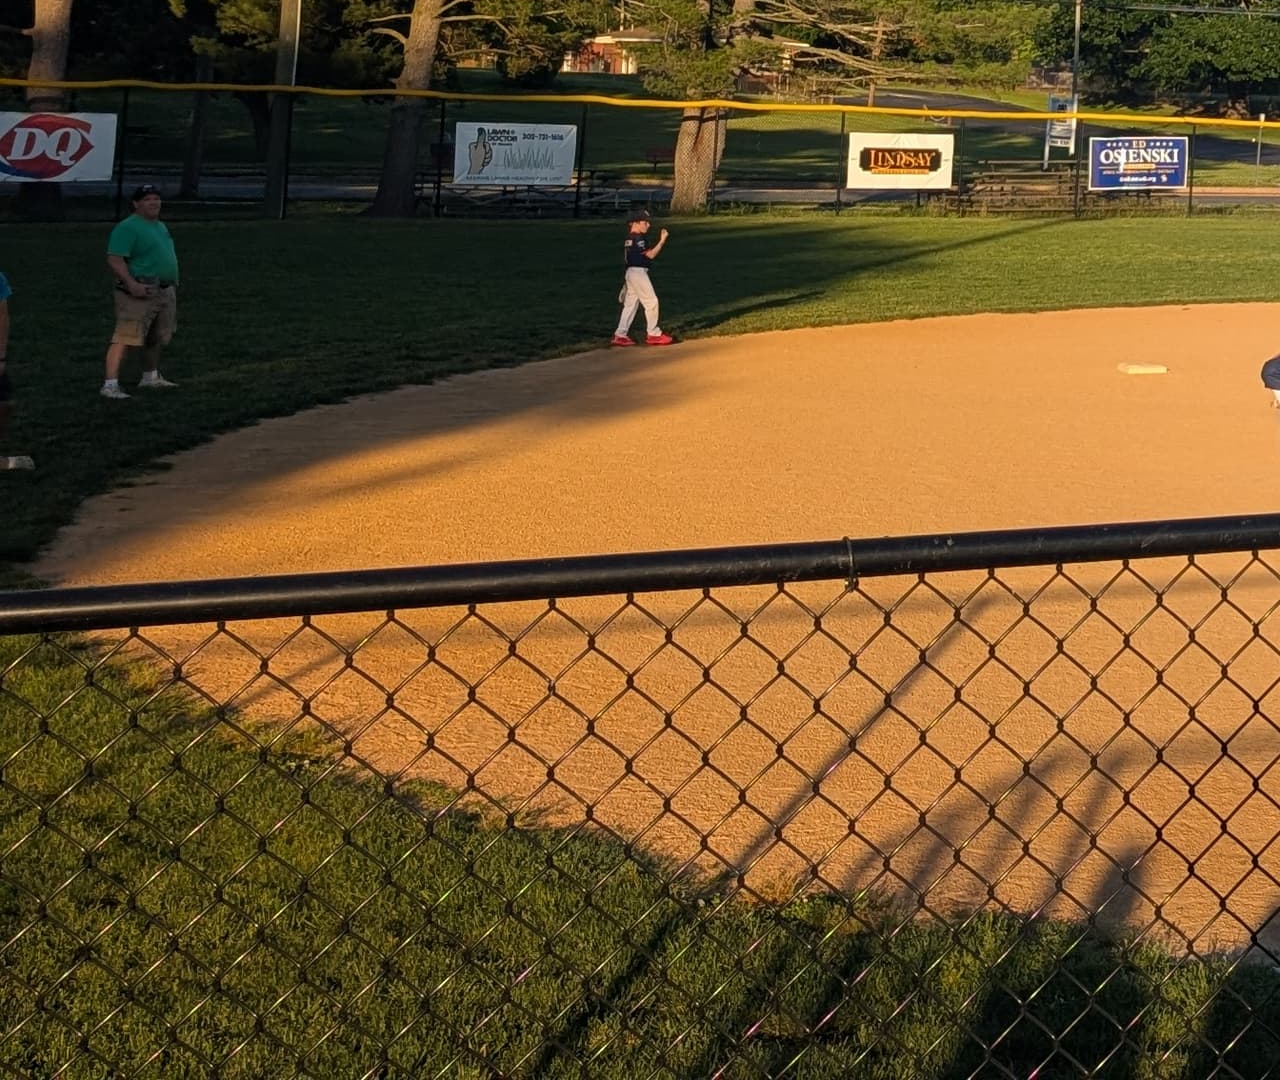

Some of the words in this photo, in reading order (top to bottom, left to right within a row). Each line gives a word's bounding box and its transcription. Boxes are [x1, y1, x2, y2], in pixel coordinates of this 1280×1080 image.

[6, 127, 82, 167] DQ
[1132, 140, 1147, 149] ED
[869, 150, 936, 169] LINDSAY
[1100, 148, 1179, 164] OSIENSKI
